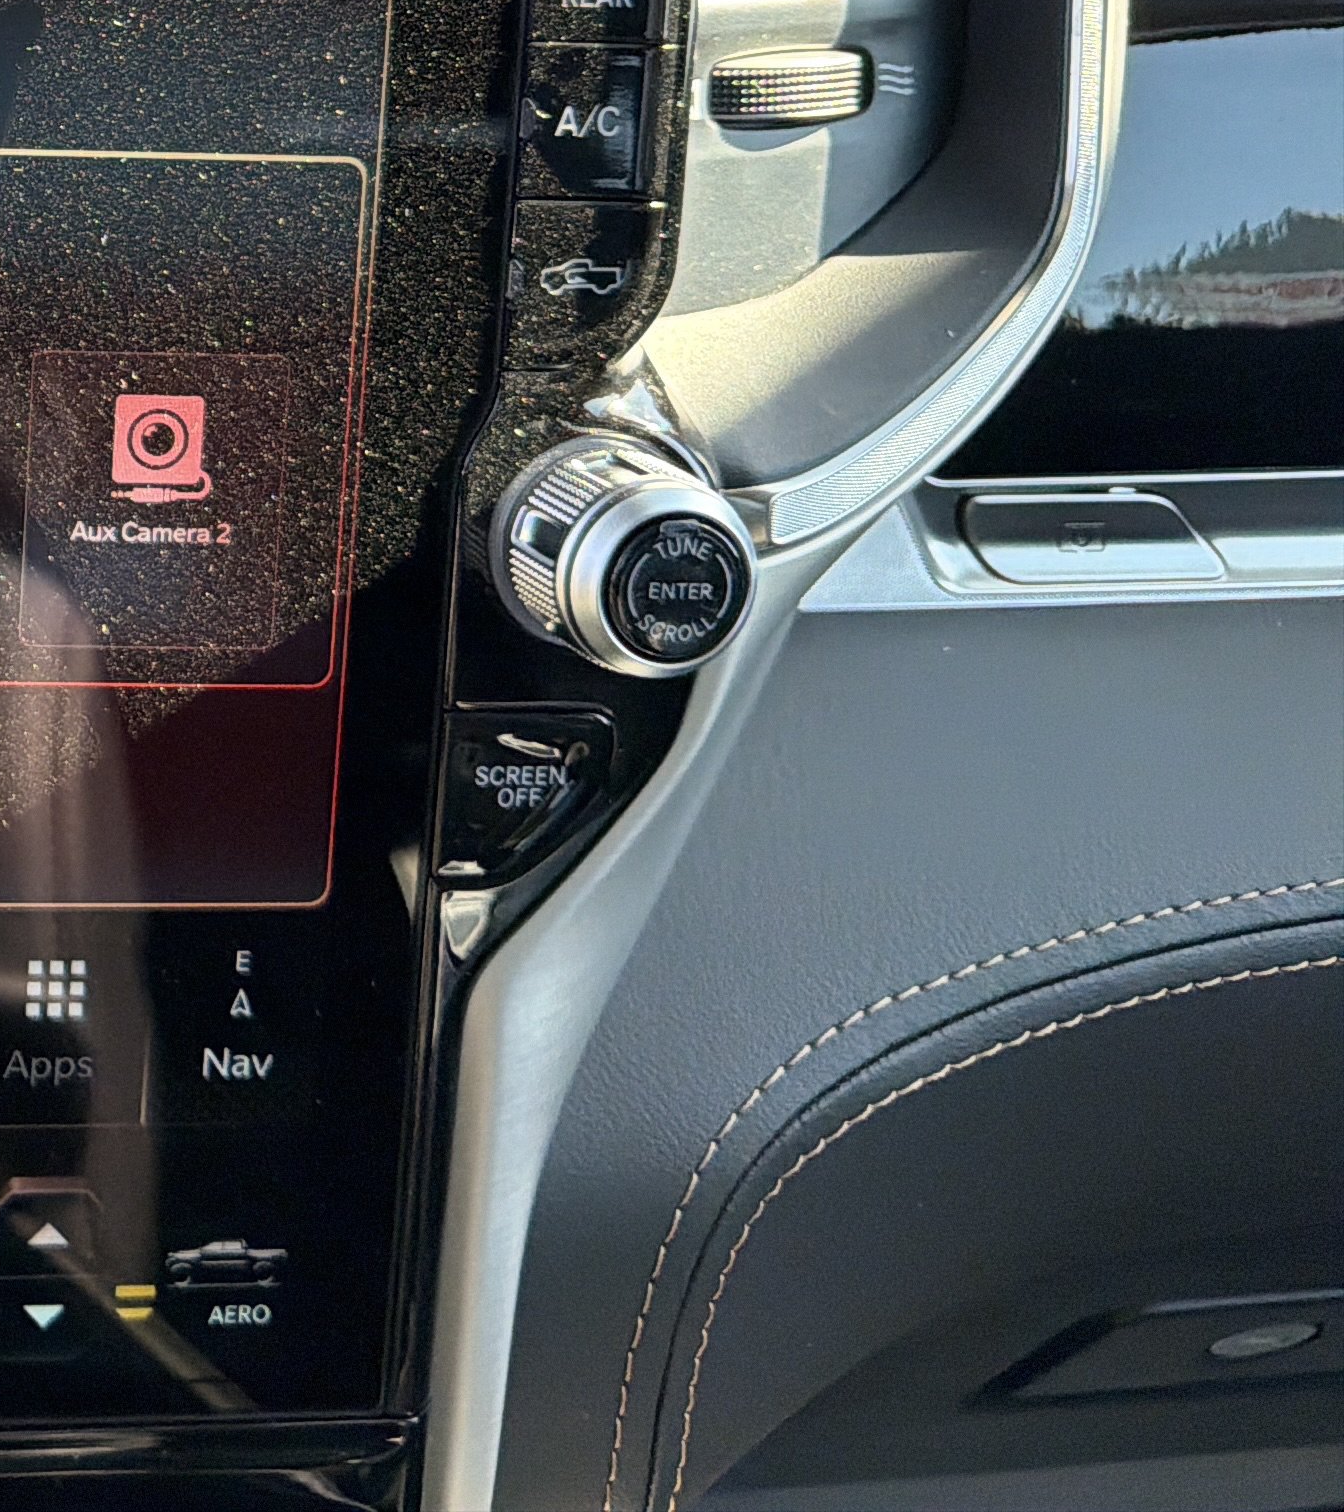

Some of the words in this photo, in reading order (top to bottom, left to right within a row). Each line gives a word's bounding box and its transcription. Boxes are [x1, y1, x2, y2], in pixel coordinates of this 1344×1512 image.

[554, 104, 621, 138] A/C
[70, 520, 116, 544] Aux
[121, 520, 212, 545] Camera
[216, 522, 233, 545] 2
[653, 537, 714, 563] TUNE
[648, 581, 714, 602] ENTER
[637, 613, 718, 644] SCROLL
[474, 765, 566, 787] SCREEN
[496, 787, 544, 810] OFF
[2, 1050, 94, 1085] Apps
[201, 1047, 275, 1082] Nav
[208, 1303, 272, 1327] AERO
